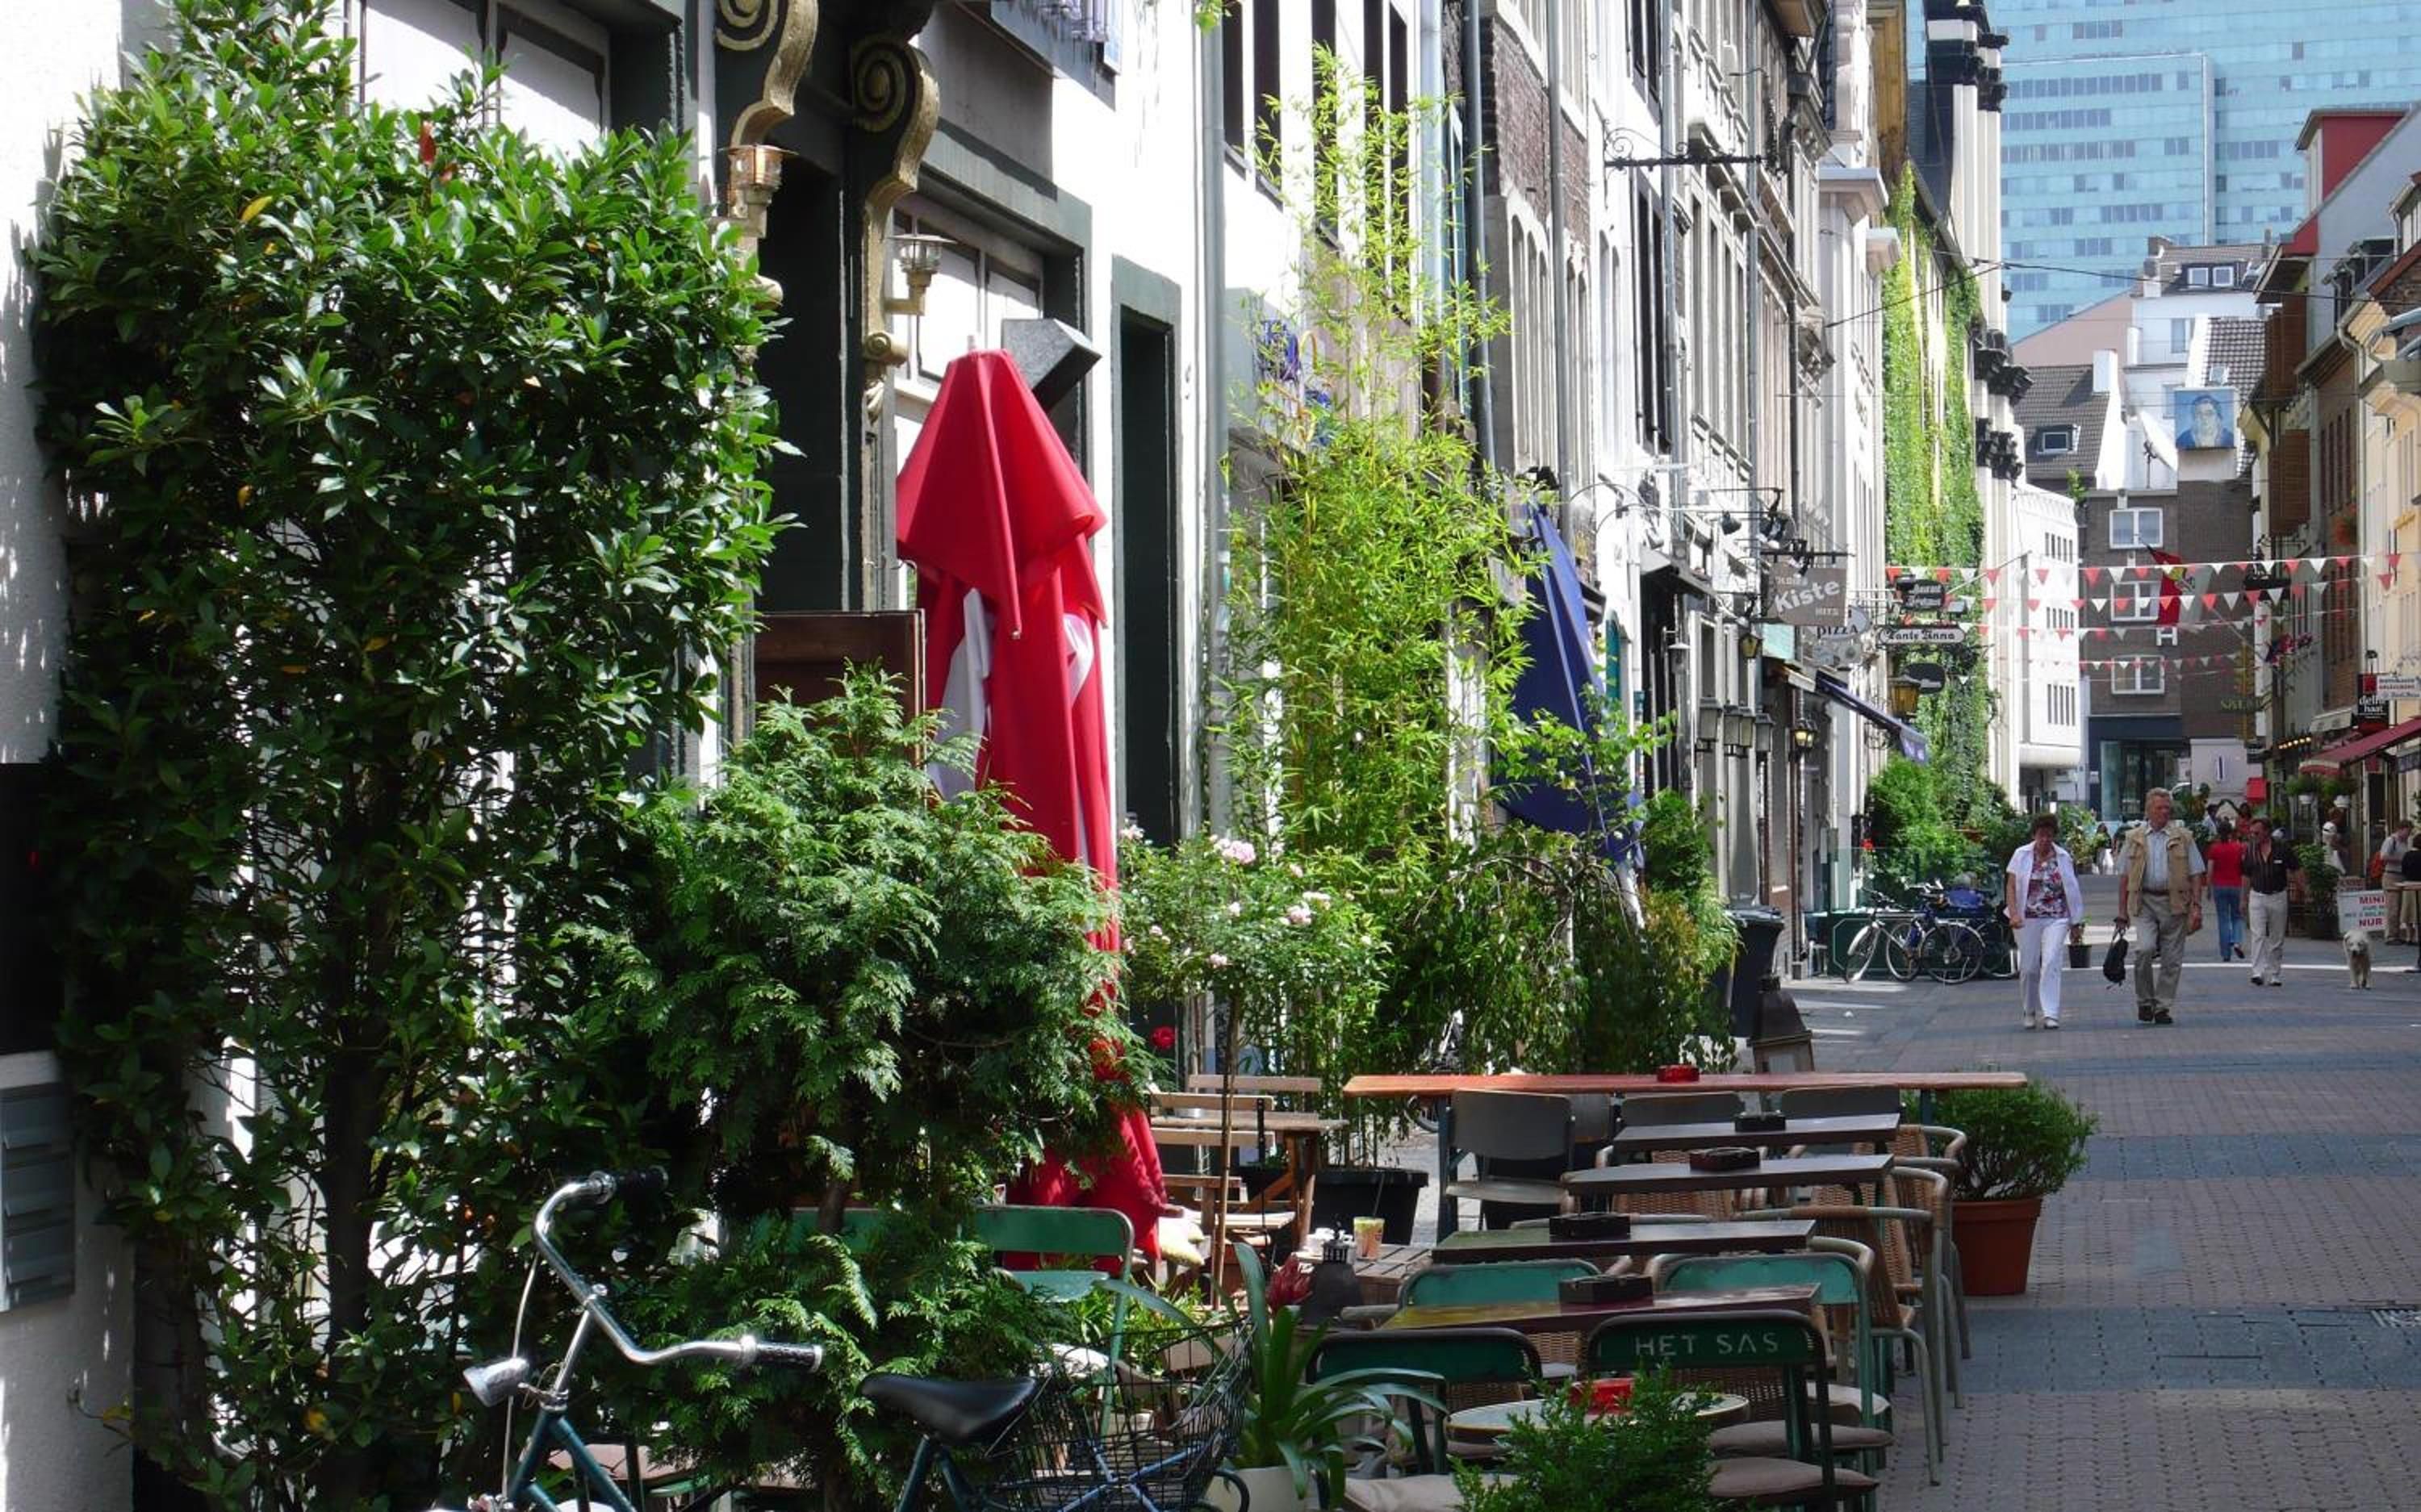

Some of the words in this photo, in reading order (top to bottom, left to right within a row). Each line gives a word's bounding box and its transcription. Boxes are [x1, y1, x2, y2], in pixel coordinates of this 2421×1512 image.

[1775, 581, 1841, 612] Kiste
[1921, 629, 1955, 640] Anna
[2359, 917, 2383, 927] NUR
[1635, 1334, 1697, 1356] HET
[1716, 1332, 1779, 1355] SAS
